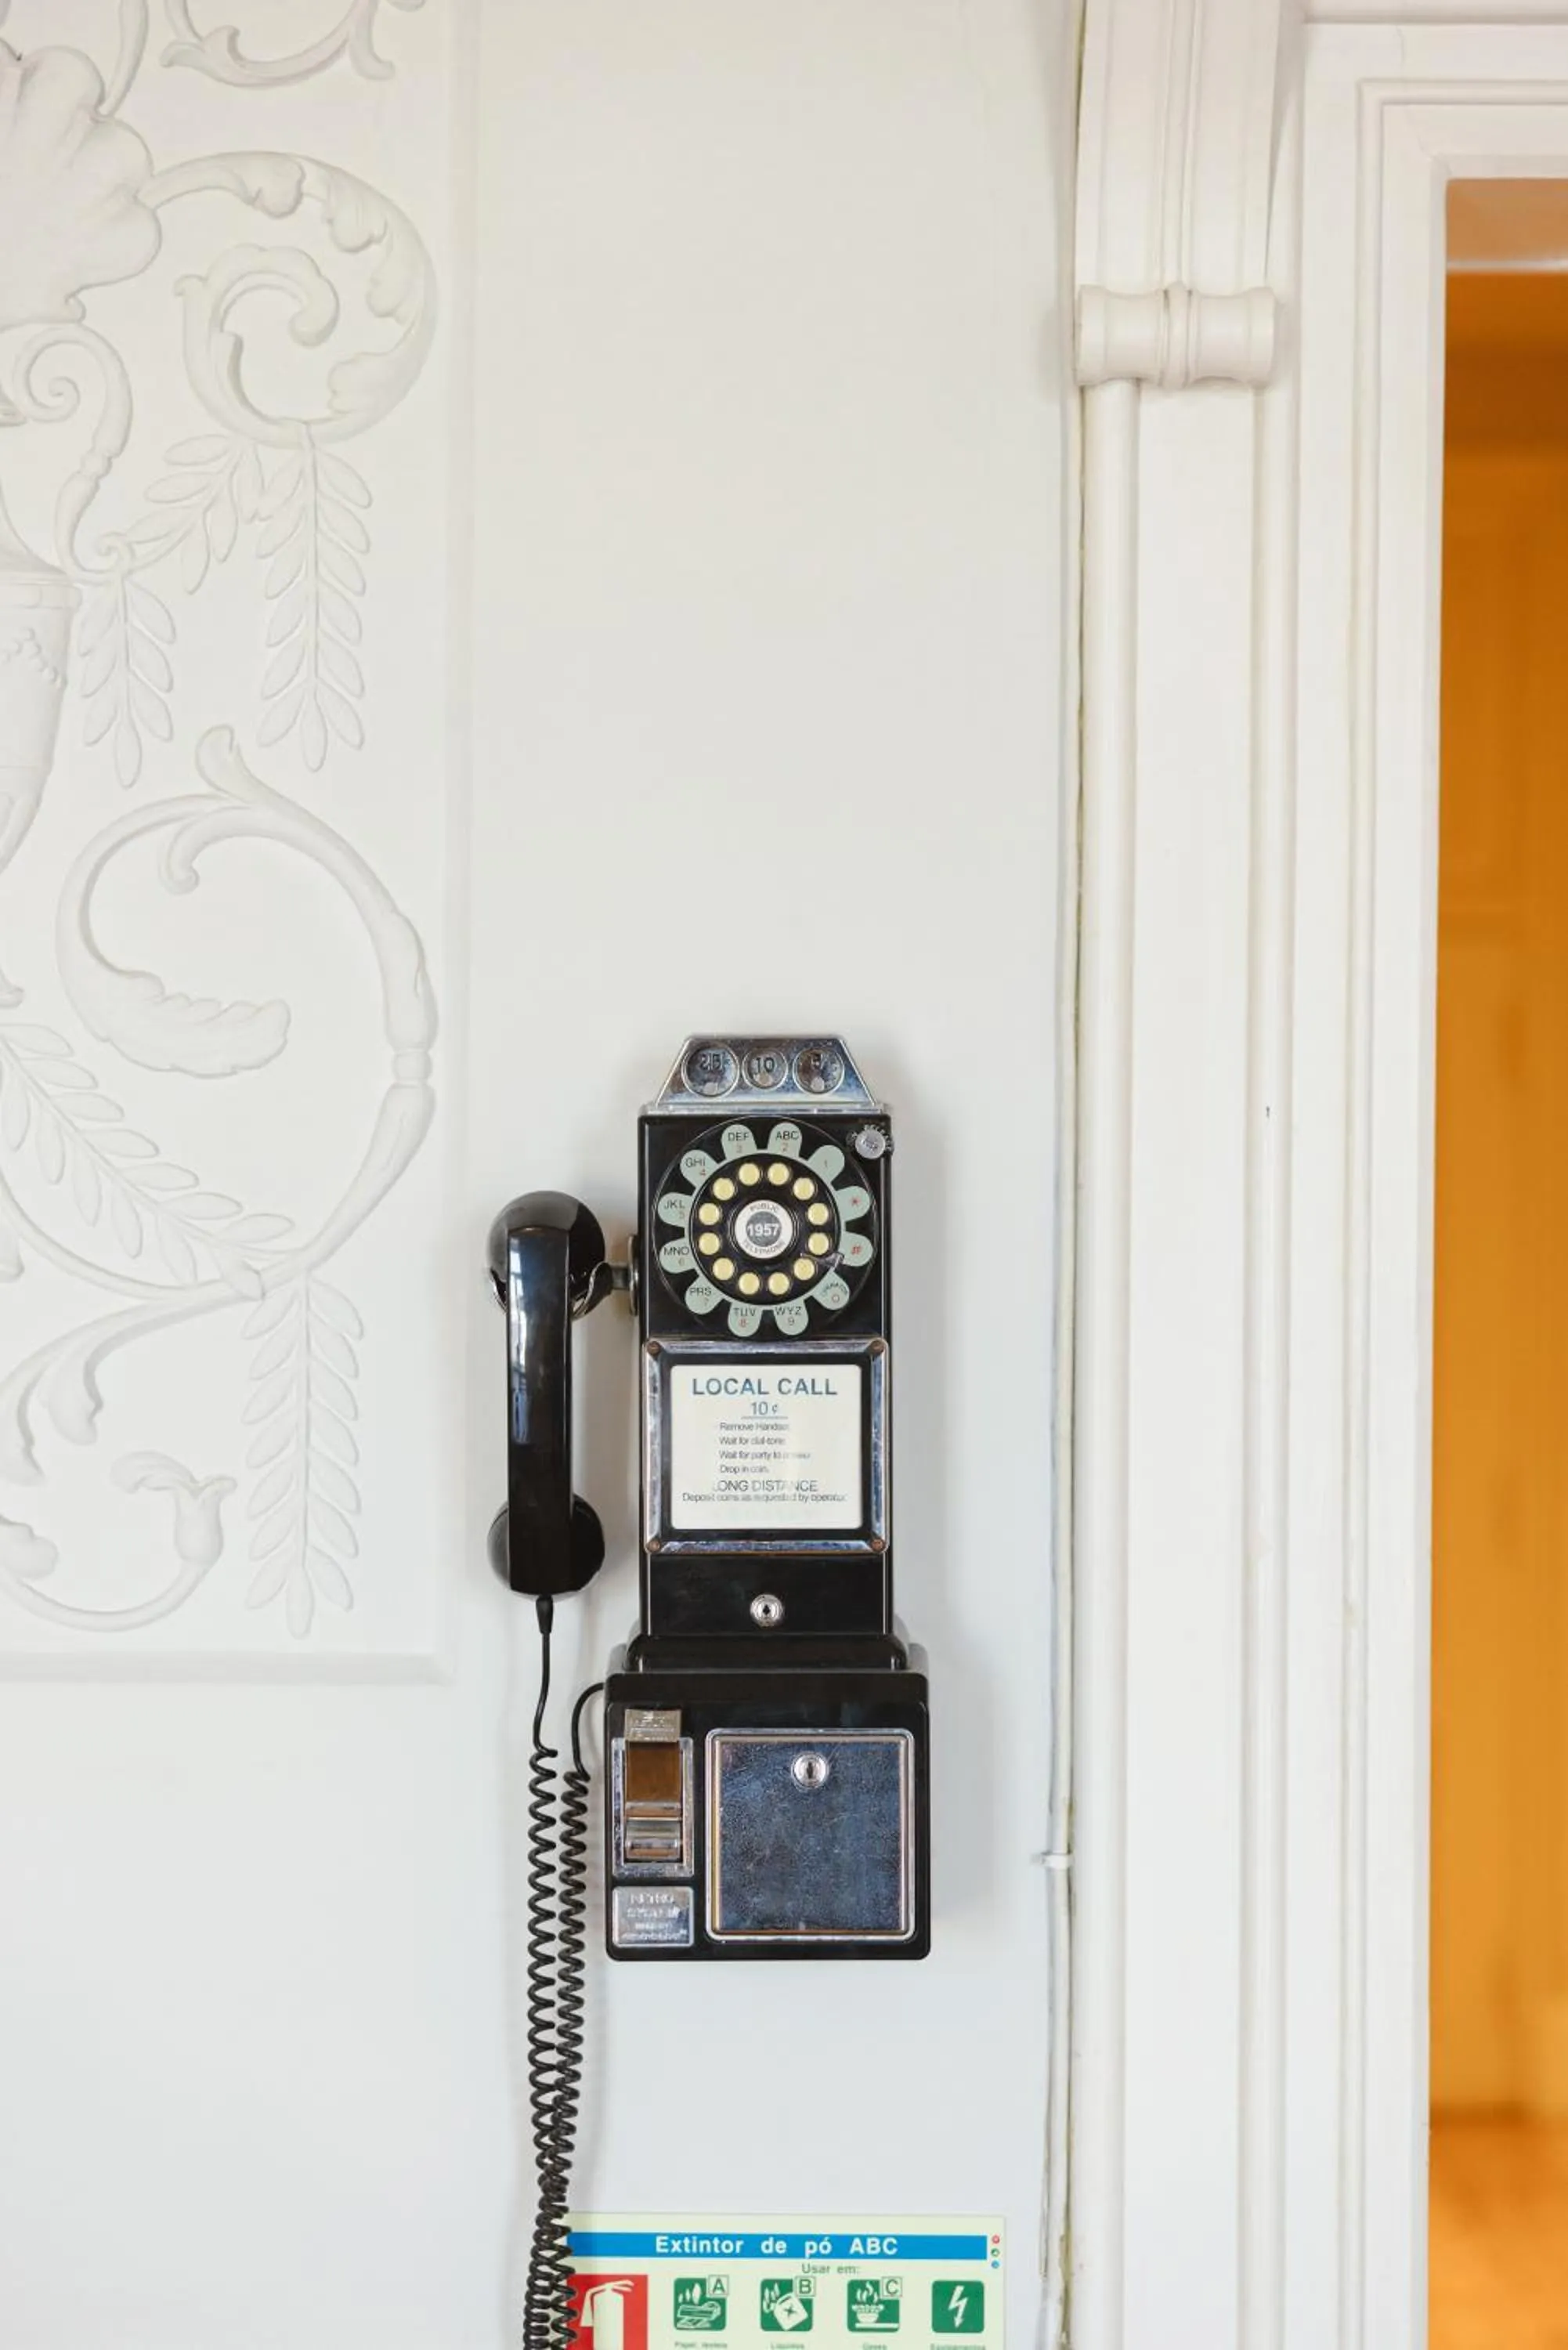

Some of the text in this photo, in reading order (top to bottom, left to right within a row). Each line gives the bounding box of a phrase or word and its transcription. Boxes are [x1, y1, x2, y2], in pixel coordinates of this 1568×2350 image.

[755, 1057, 775, 1073] 10
[728, 1131, 750, 1142] DEF
[775, 1130, 800, 1141] ABC
[685, 1157, 706, 1168] GHI
[663, 1199, 685, 1209] JKL
[747, 1223, 779, 1237] 1957
[663, 1246, 689, 1256] MNO
[689, 1287, 712, 1296] PRS
[733, 1307, 757, 1317] TUV
[775, 1306, 802, 1316] WYZ
[692, 1377, 838, 1395] LOCAL CALL
[719, 1422, 754, 1431] Remove
[719, 1437, 737, 1445] Wait
[739, 1437, 750, 1445] for
[719, 1451, 737, 1459] Wait
[739, 1451, 750, 1459] for
[751, 1452, 771, 1462] party
[720, 1465, 740, 1474] Drop
[751, 1479, 819, 1492] DISTNCE
[798, 1492, 808, 1503] by
[656, 2236, 898, 2259] Extintor de pó ABC
[801, 2263, 861, 2274] Usar em:
[712, 2277, 725, 2294] A
[799, 2279, 812, 2295] B
[885, 2278, 899, 2295] C
